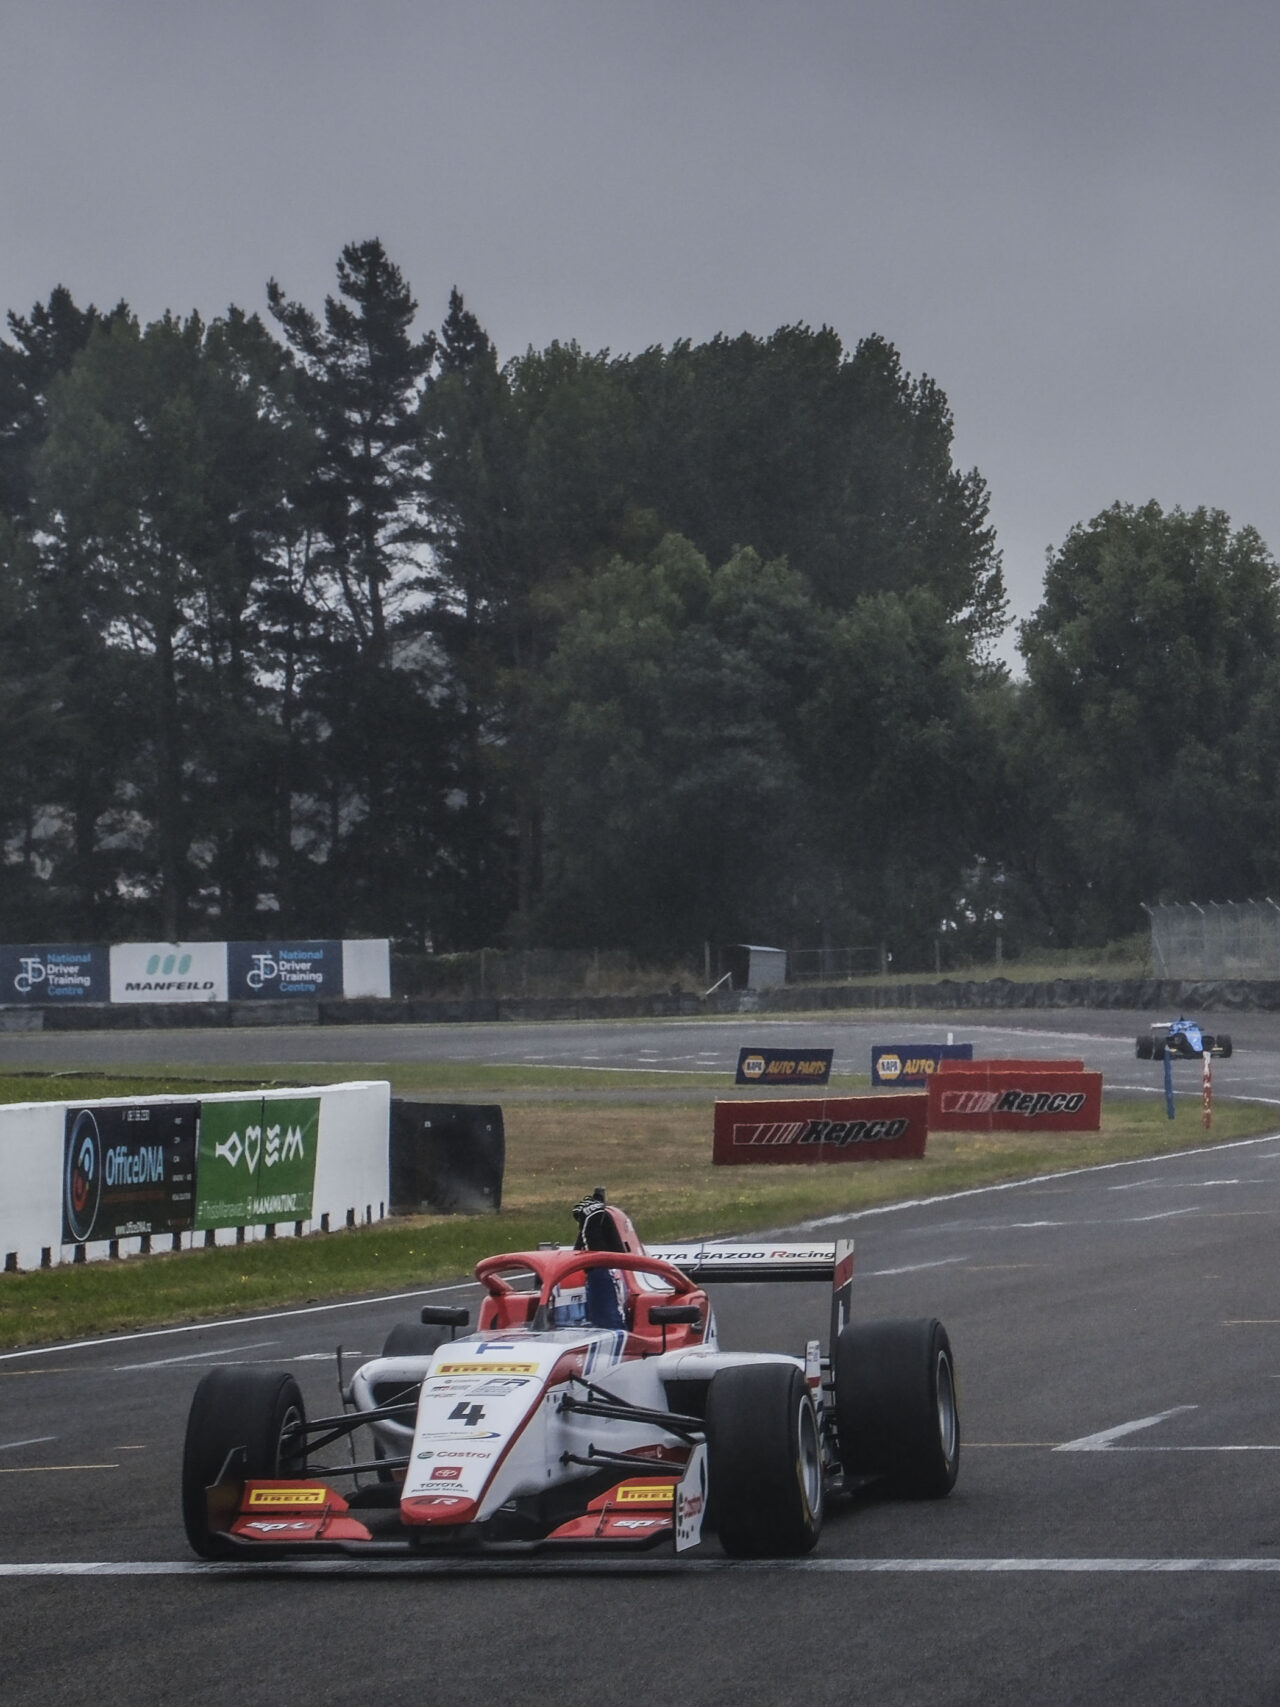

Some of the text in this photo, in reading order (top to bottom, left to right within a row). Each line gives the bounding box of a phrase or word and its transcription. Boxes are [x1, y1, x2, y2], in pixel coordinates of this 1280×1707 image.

[47, 952, 91, 963] National
[279, 949, 323, 960] National
[47, 964, 80, 974] Driver
[279, 961, 312, 971] Driver
[47, 975, 91, 987] Training
[279, 972, 323, 984] Training
[47, 986, 84, 996] Centre
[125, 981, 215, 992] MANFEILD
[279, 982, 316, 992] Centre
[766, 1060, 827, 1074] AUTO PARTS
[903, 1059, 935, 1074] AUTO
[996, 1089, 1086, 1116] Repco
[800, 1118, 909, 1147] Repco
[105, 1145, 164, 1187] OfficeDNA
[650, 1250, 836, 1261] OTA GAZOO Racing
[440, 1364, 532, 1373] PIRELLI
[447, 1401, 487, 1427] 4
[436, 1451, 492, 1459] Castrol
[254, 1492, 321, 1502] PIRELLI
[622, 1489, 675, 1499] PIREL
